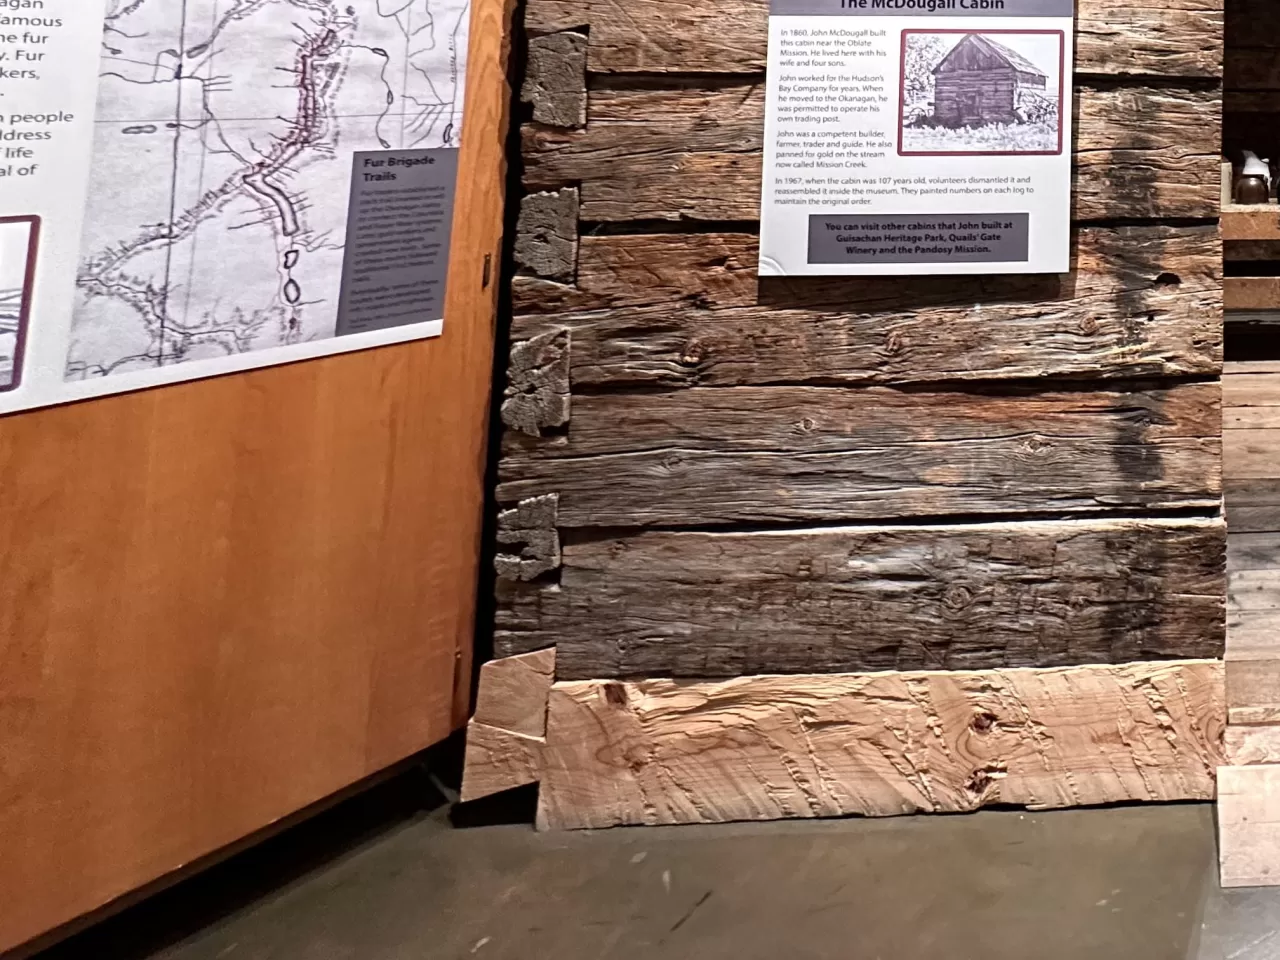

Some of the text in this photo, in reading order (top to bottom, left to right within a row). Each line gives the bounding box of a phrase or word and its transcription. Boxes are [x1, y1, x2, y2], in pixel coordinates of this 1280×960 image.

[23, 32, 49, 44] fur
[830, 29, 868, 38] McDougall
[16, 50, 45, 61] Fur
[779, 85, 791, 93] Bay
[793, 85, 827, 93] Company
[793, 105, 829, 113] permitted
[840, 105, 868, 113] operate
[10, 111, 73, 125] people
[795, 115, 820, 123] trading
[818, 131, 856, 139] competent
[5, 148, 33, 158] life
[776, 151, 803, 159] panned
[817, 151, 833, 159] gold
[364, 156, 435, 168] Fur Brigade
[17, 164, 37, 176] of
[363, 171, 397, 182] Trails
[901, 187, 918, 195] They
[920, 187, 947, 195] painted
[1013, 187, 1024, 195] log
[822, 198, 849, 206] original
[884, 234, 922, 244] Heritage
[846, 247, 876, 256] Winery
[915, 246, 953, 255] Pandosy
